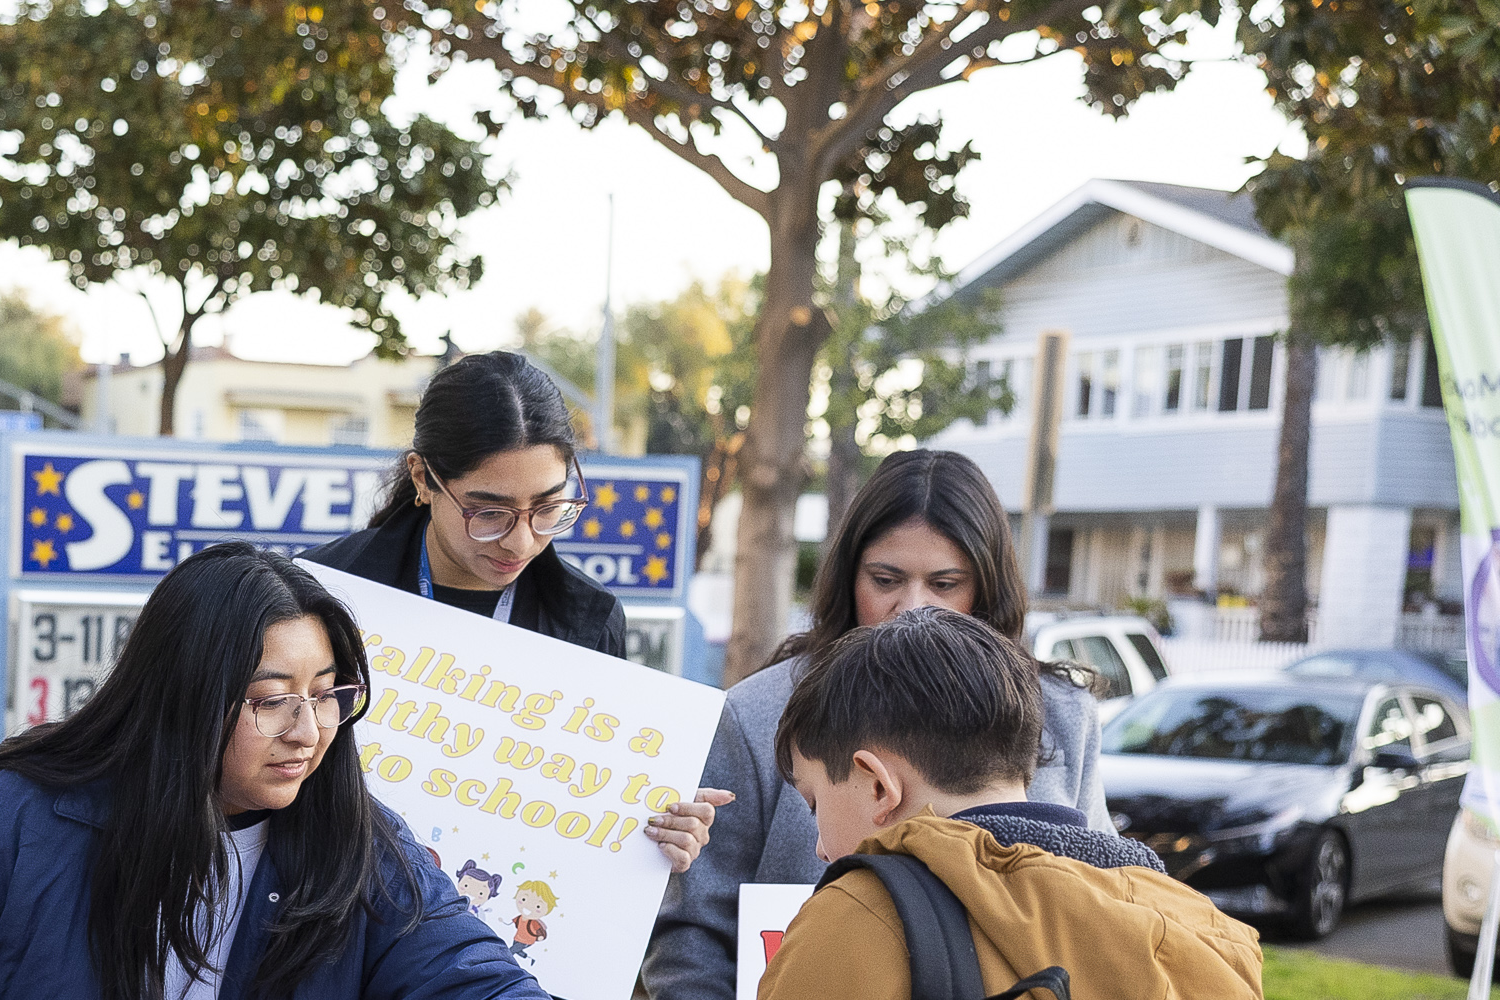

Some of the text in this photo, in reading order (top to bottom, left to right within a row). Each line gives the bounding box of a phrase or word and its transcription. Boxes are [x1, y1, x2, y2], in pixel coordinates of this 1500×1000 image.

[364, 687, 682, 813] lthy way to
[562, 697, 621, 743] is
[629, 727, 665, 757] a
[359, 742, 639, 853] to school!
